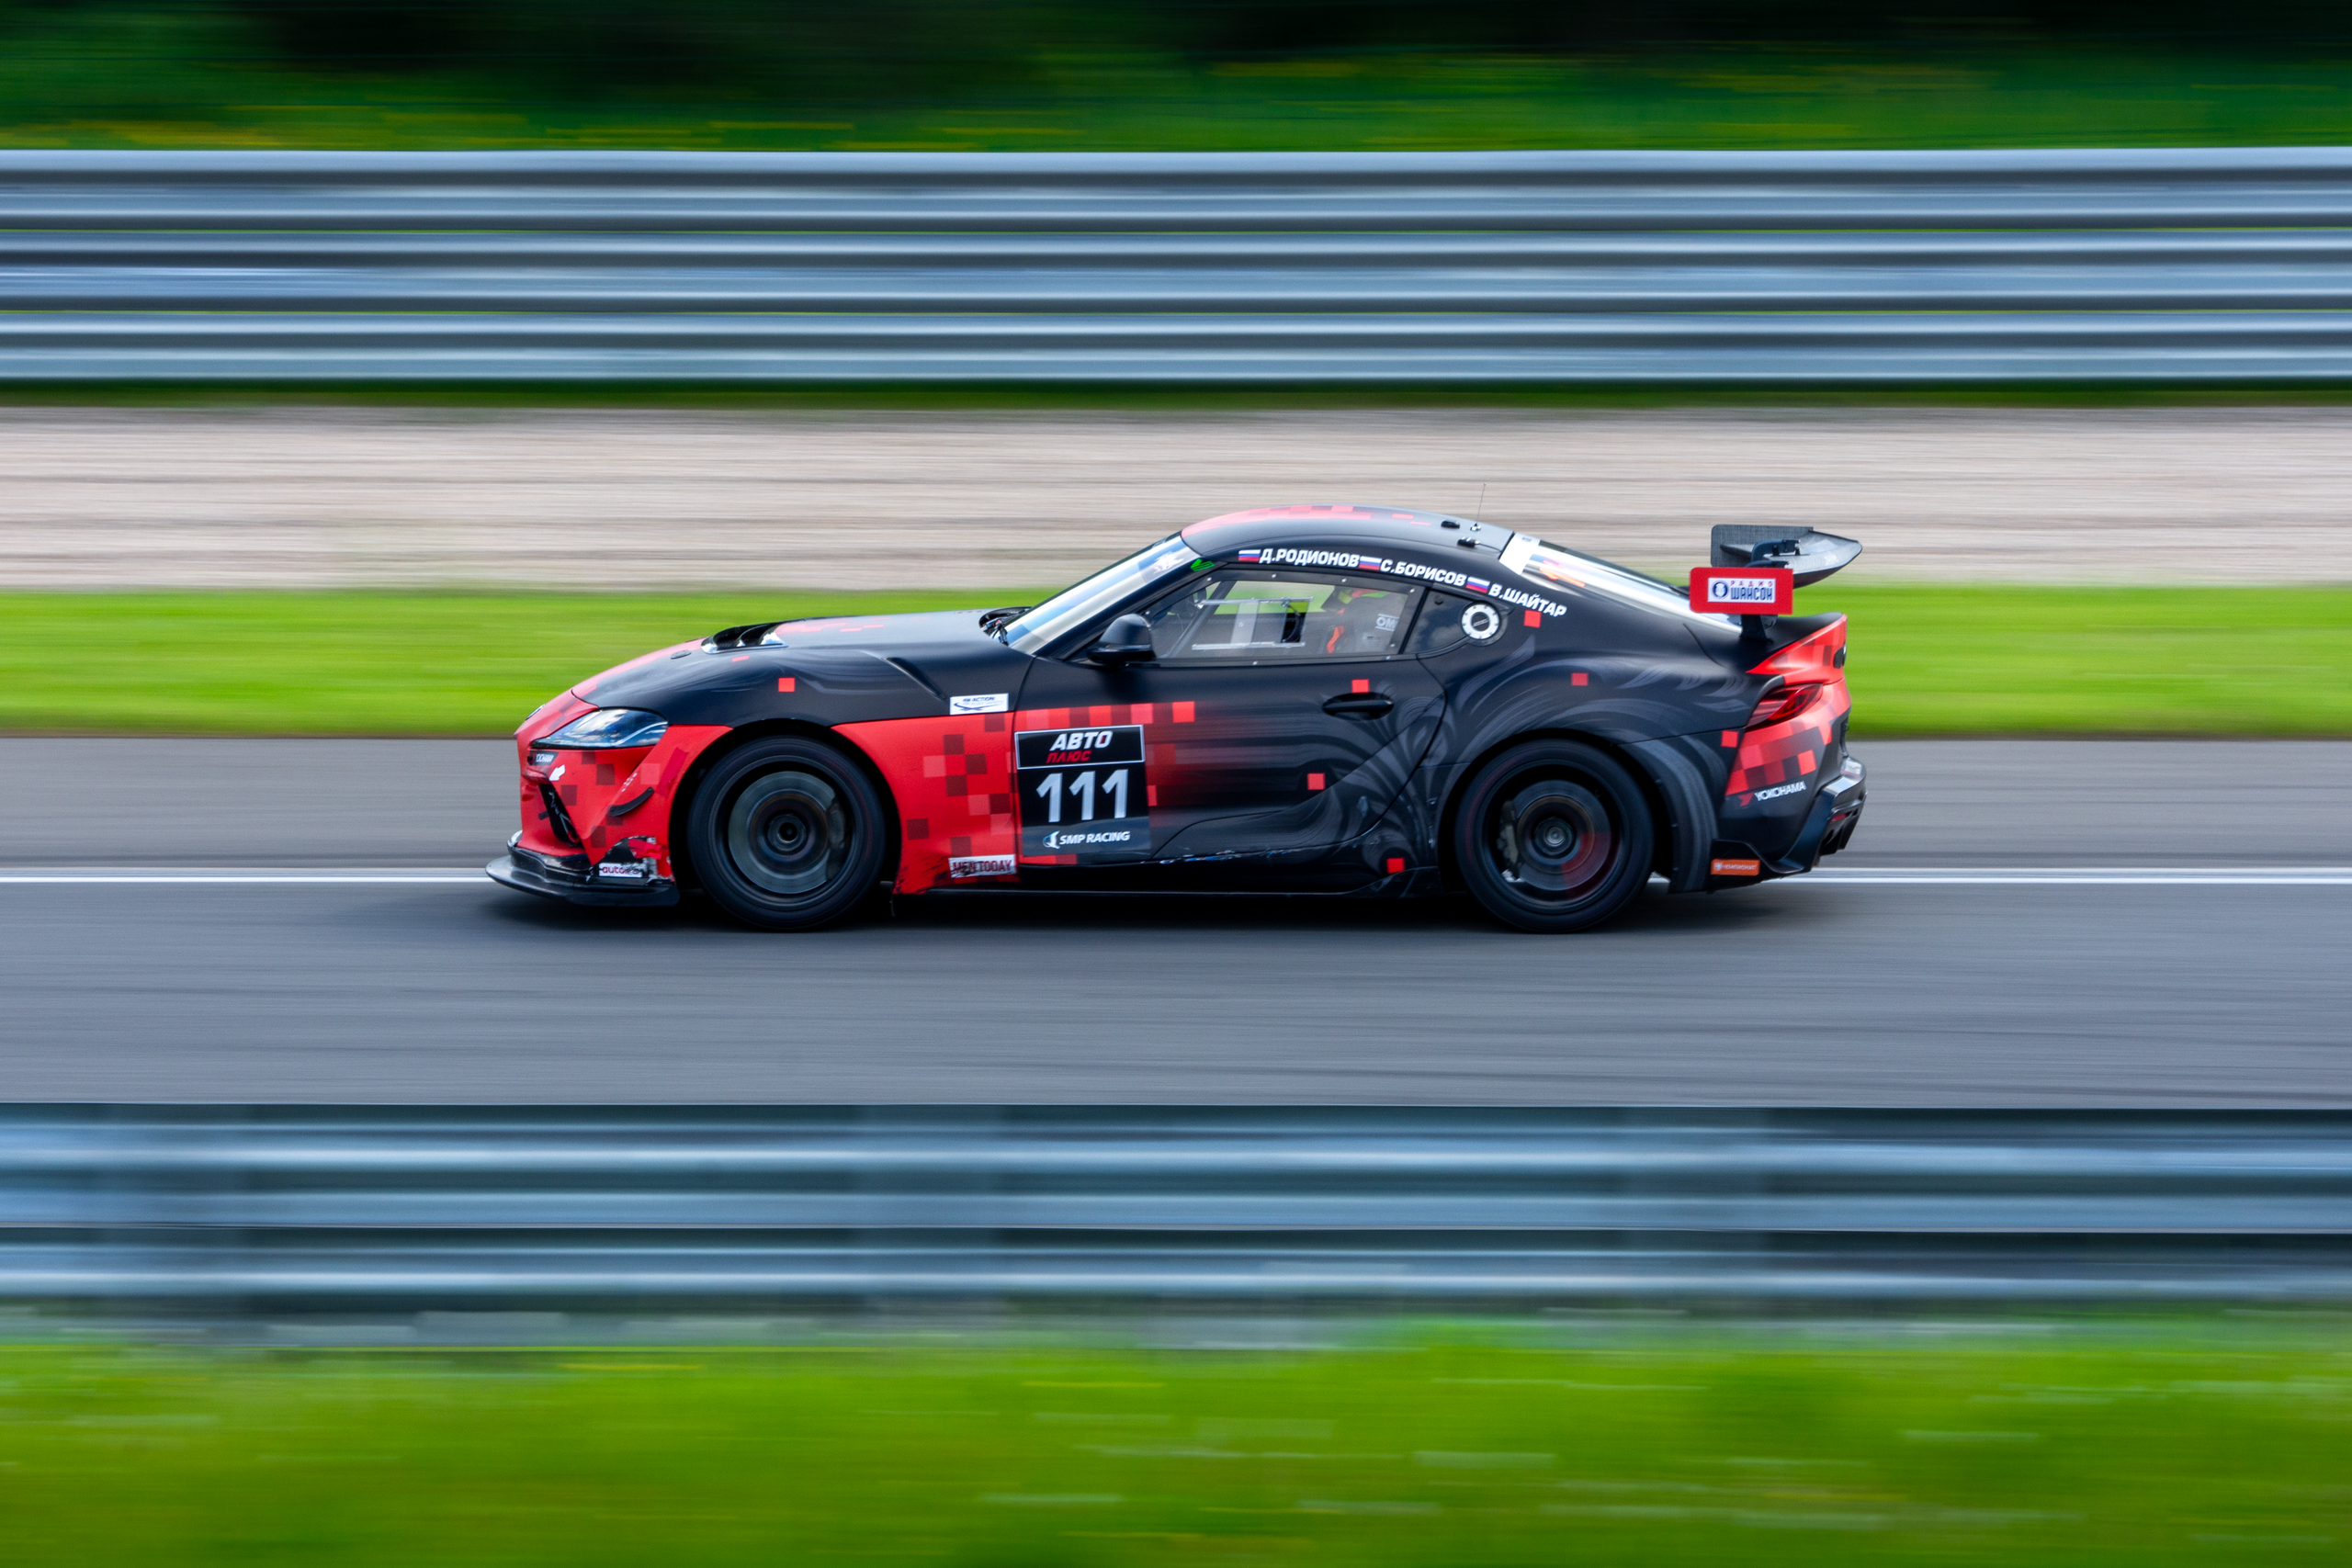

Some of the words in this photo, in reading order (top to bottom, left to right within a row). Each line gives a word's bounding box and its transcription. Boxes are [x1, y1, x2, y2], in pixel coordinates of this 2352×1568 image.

[1259, 548, 1360, 568] Д.РОДИОНОВ
[1380, 558, 1467, 587] С.БОРИСОВ
[1487, 583, 1567, 617] В.ШАЙТАР
[1730, 587, 1773, 600] ШАНСОН
[1049, 730, 1114, 751] АВТО
[1046, 750, 1092, 763] ПЛЮС
[1036, 769, 1128, 823] 111
[1754, 781, 1807, 801] YOKOHAMA
[1059, 834, 1086, 845] SMP
[1086, 830, 1131, 844] RACING
[978, 860, 1012, 872] TODAY
